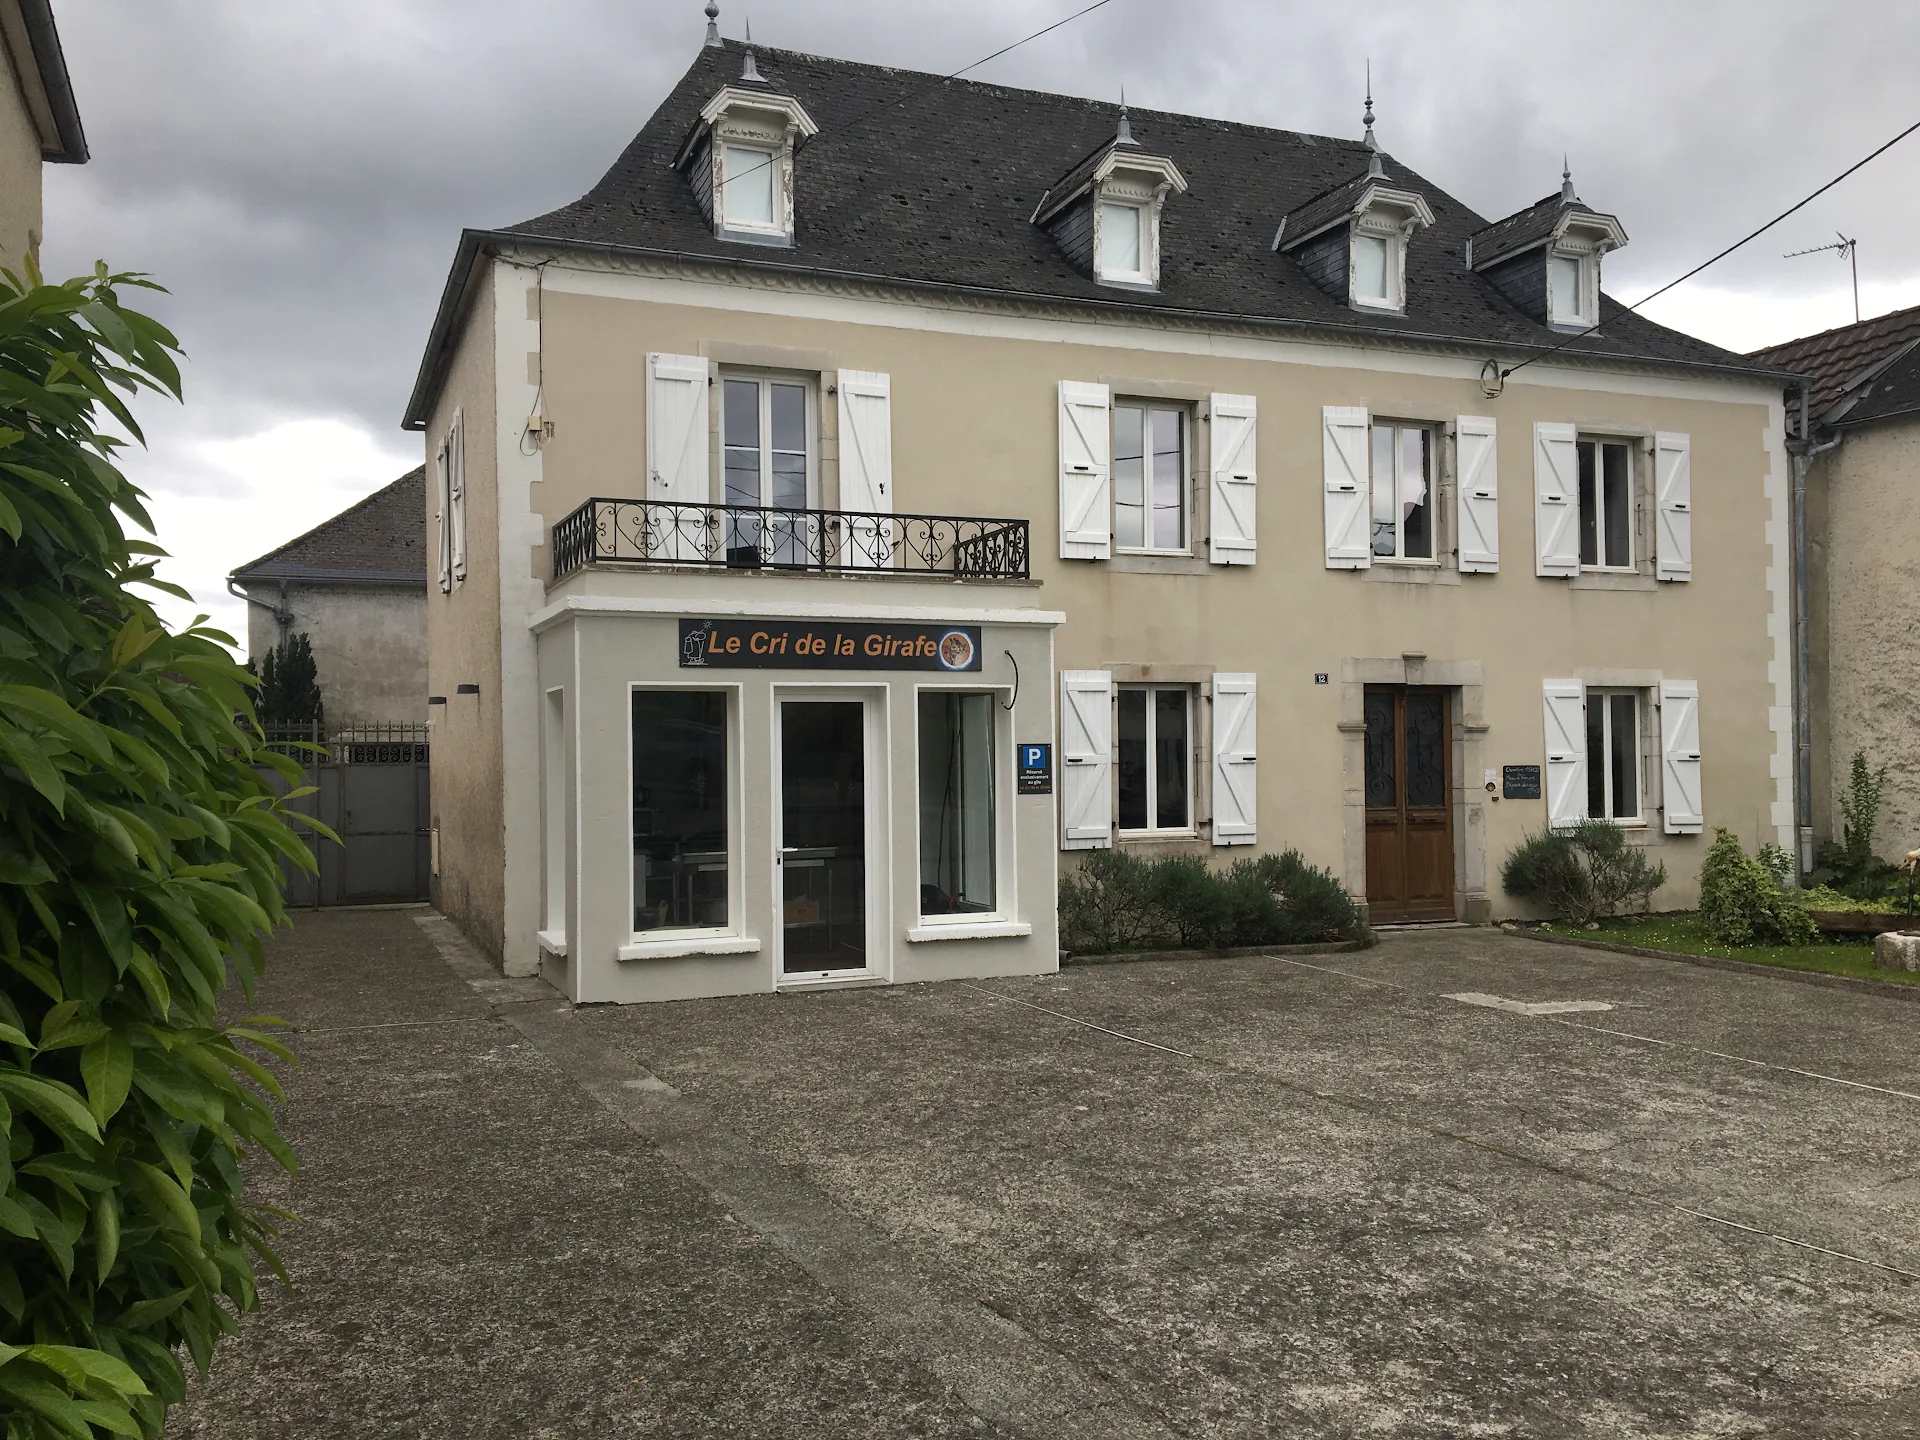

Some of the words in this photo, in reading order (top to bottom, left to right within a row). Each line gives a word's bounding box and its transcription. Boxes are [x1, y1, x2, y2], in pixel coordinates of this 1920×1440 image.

[708, 630, 741, 654] Le
[750, 632, 788, 655] Cri
[794, 633, 827, 656] de
[833, 633, 856, 656] la
[863, 635, 938, 658] Girafe
[1028, 748, 1041, 766] P
